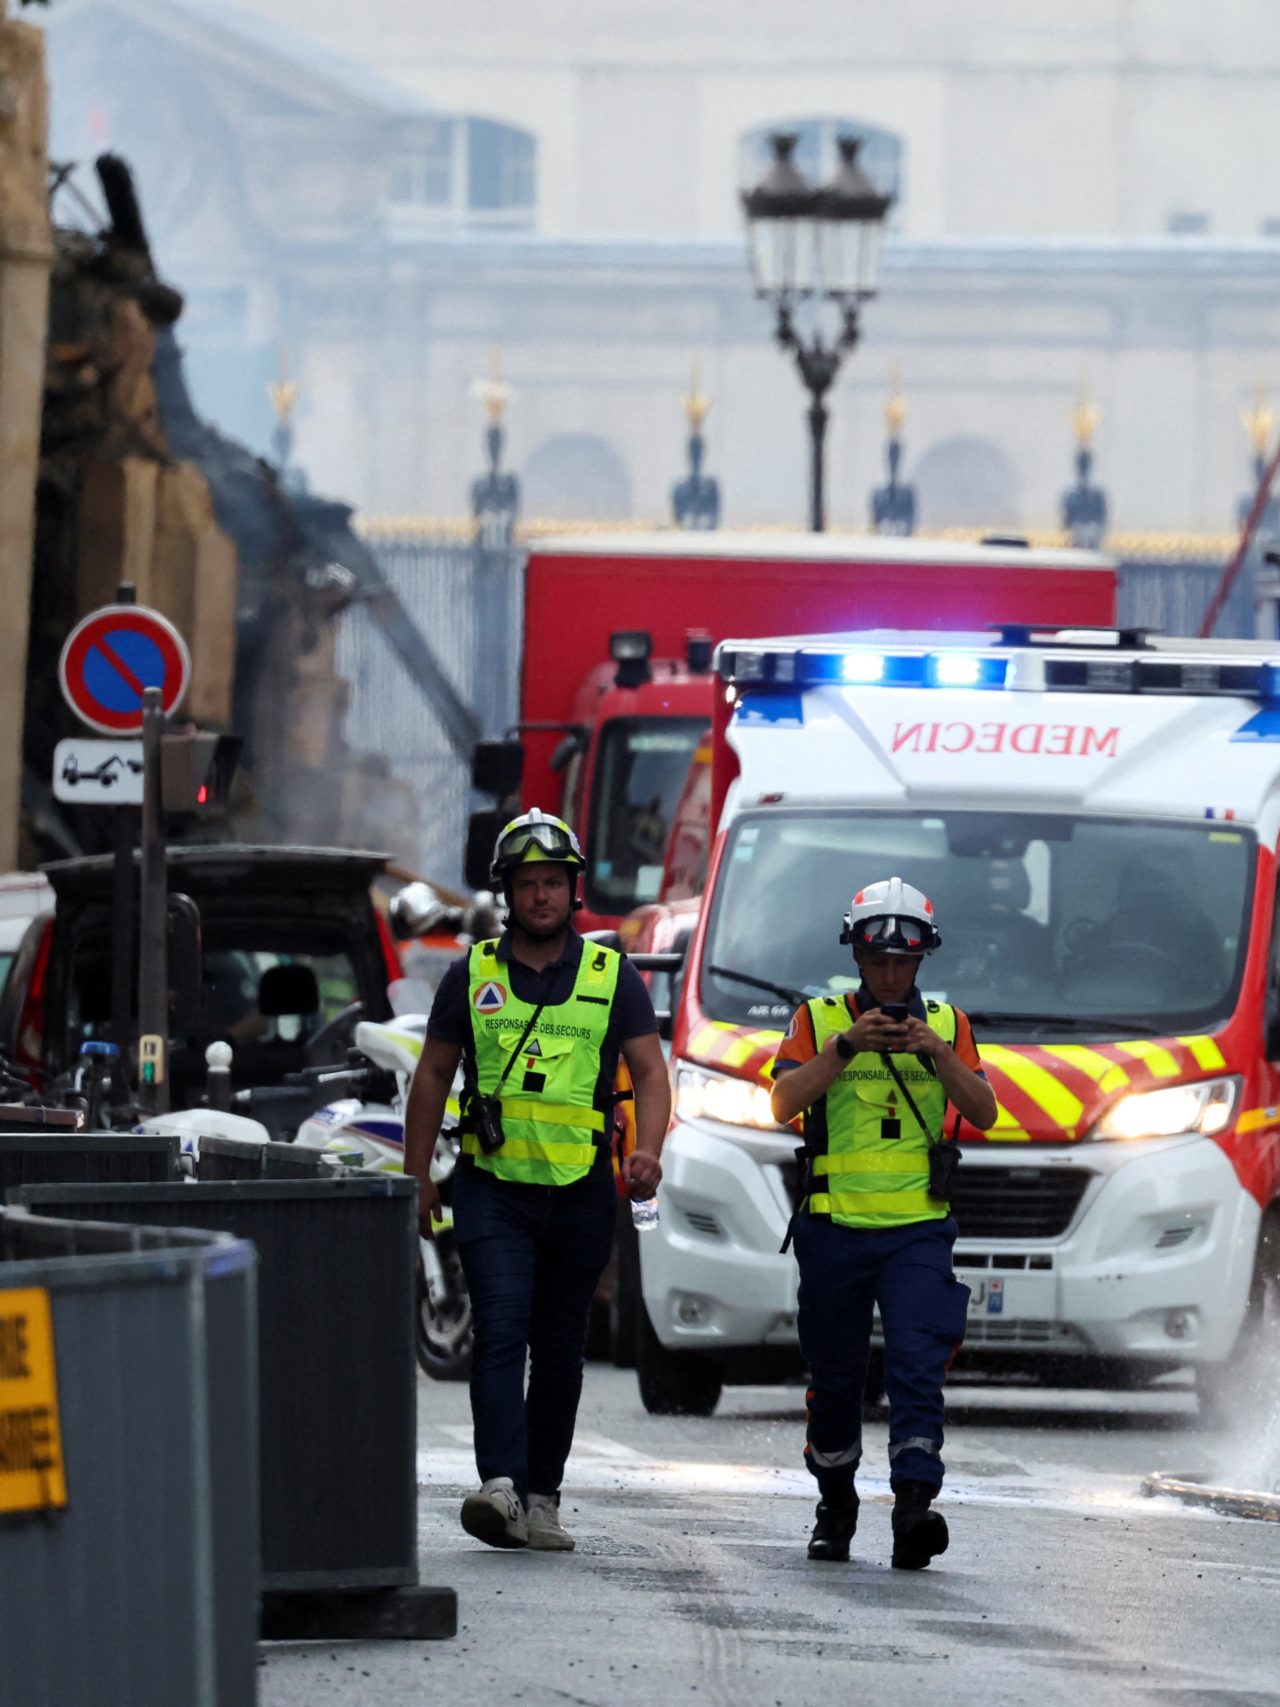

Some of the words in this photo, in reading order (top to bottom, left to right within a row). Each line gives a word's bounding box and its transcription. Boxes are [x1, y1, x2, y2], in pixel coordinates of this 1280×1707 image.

[485, 1018, 539, 1032] RESPONSABE
[540, 1023, 554, 1035] DES
[555, 1025, 591, 1040] SECOURS
